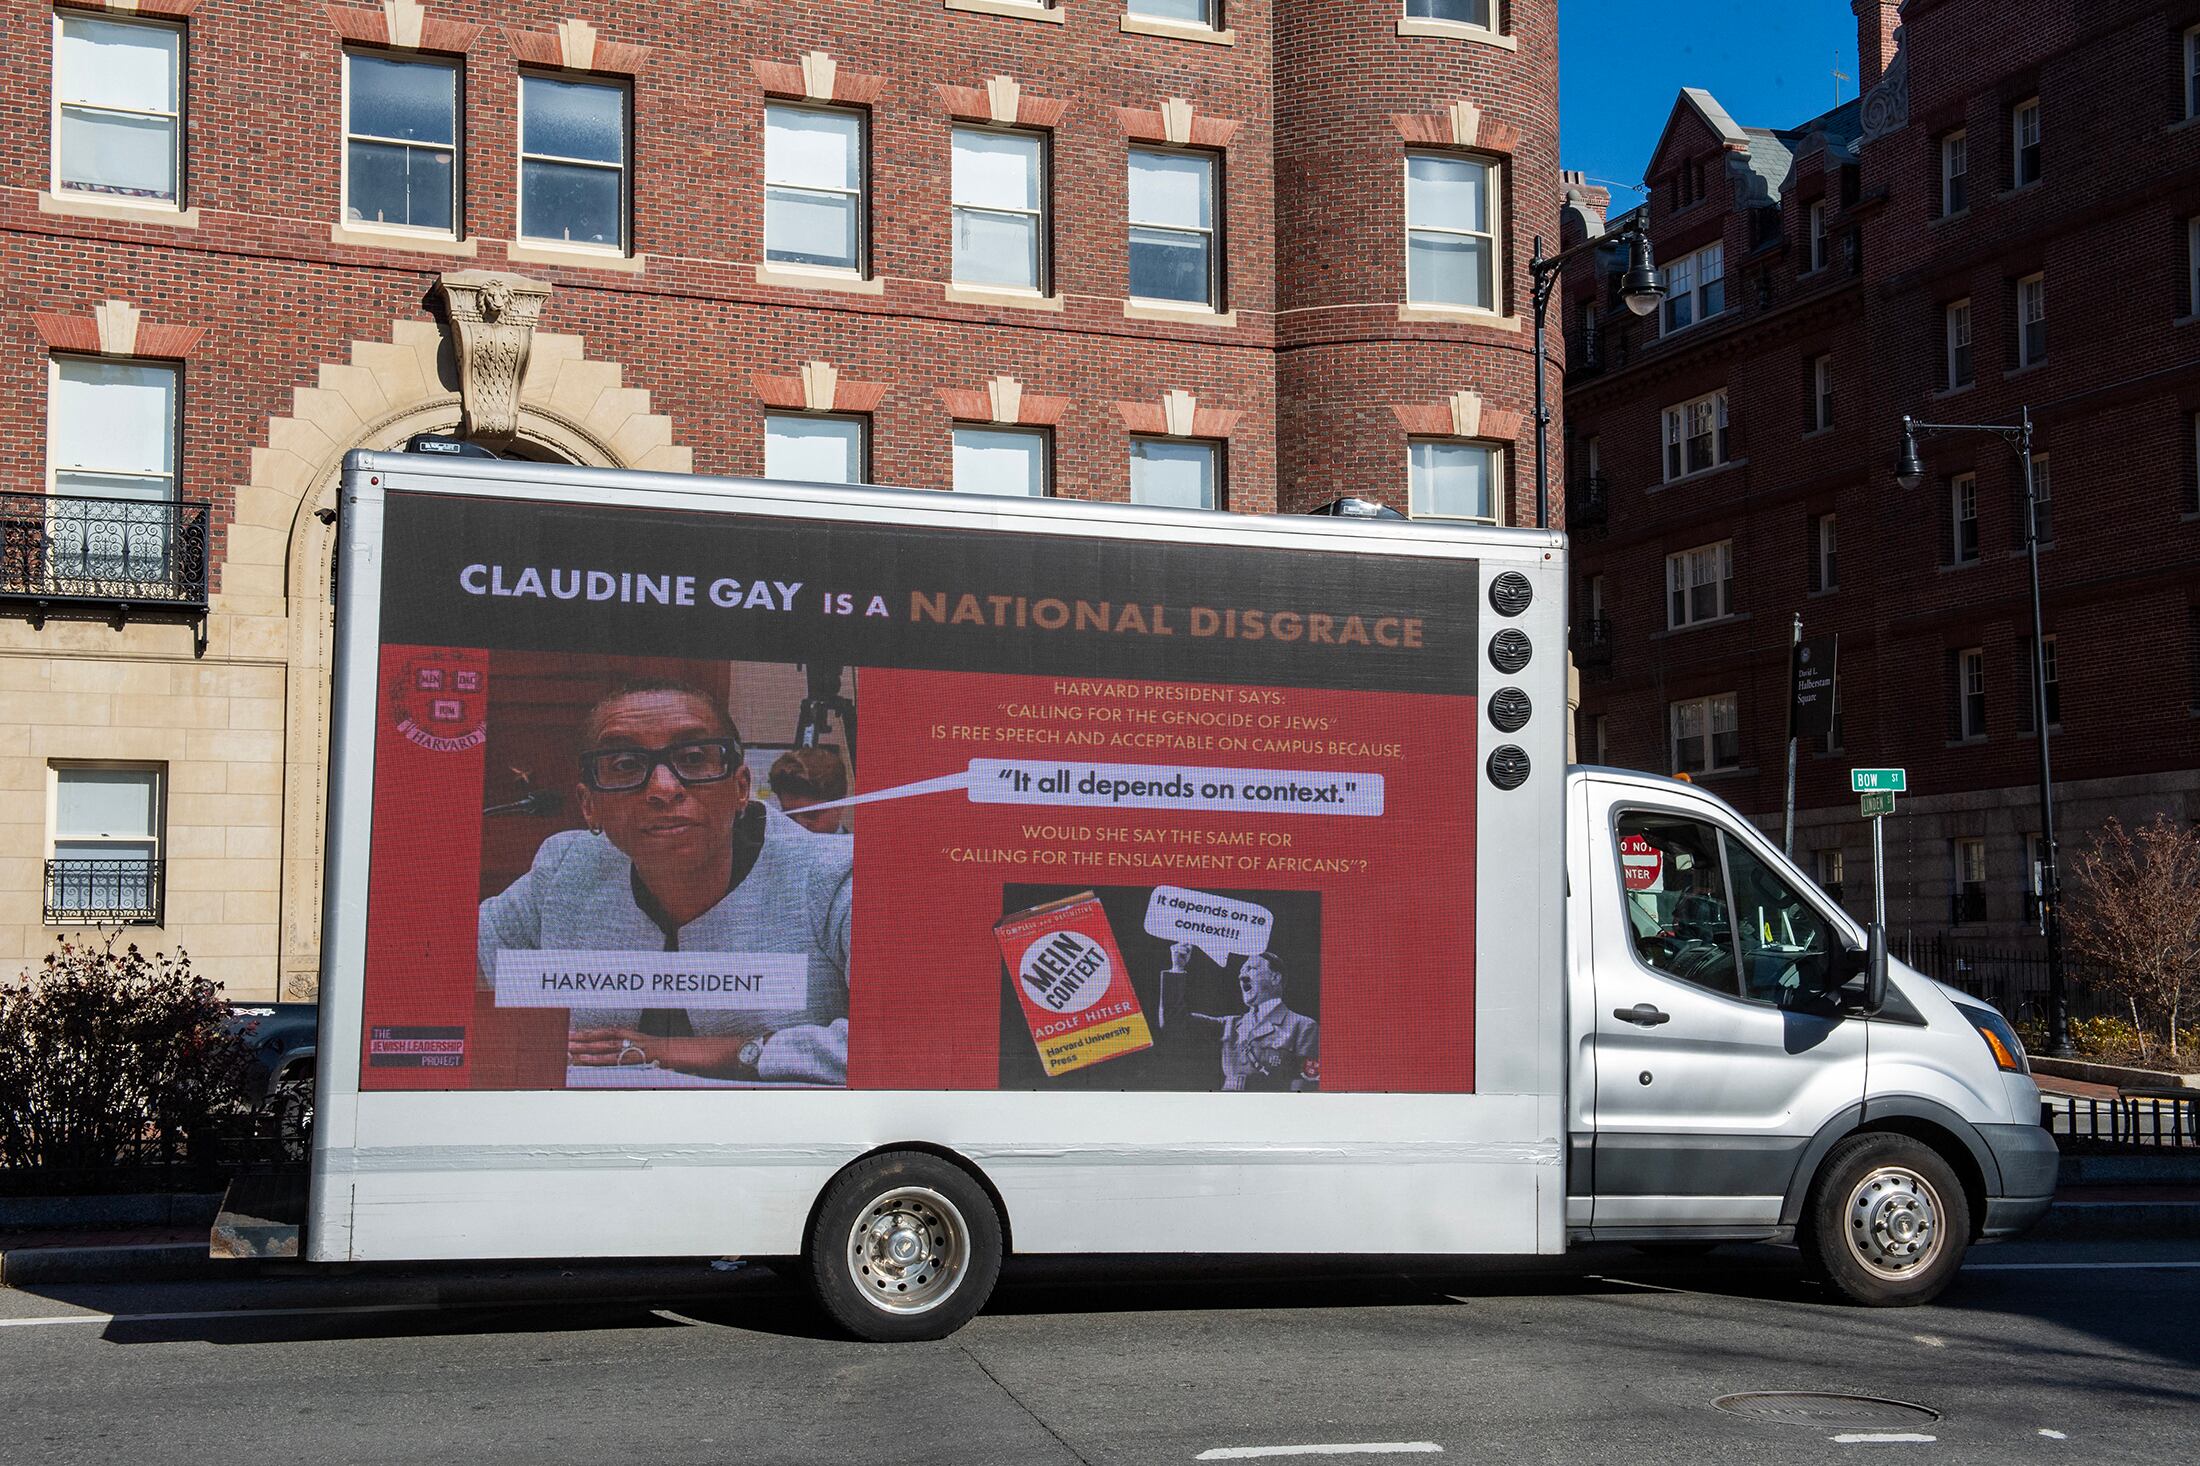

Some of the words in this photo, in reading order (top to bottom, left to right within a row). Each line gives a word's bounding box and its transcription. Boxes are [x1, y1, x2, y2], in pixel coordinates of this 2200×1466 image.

[459, 563, 696, 606] CLAUDINE
[708, 577, 804, 612] GAY
[823, 592, 854, 616] IS
[865, 595, 890, 617] A
[909, 590, 1173, 636] NATIONAL
[1190, 606, 1424, 649] DISGRACE
[1798, 667, 1812, 677] David
[1054, 681, 1139, 698] HARVARD
[1144, 685, 1234, 703] PRESIDENT
[1238, 690, 1286, 705] SAYS:
[1798, 679, 1831, 690] Halberstam
[1797, 694, 1816, 706] Square
[1088, 707, 1122, 722] FOR
[1126, 708, 1158, 723] THE
[1162, 710, 1253, 728] GENOCIDE
[1257, 714, 1281, 729] OF
[412, 731, 479, 751] HARVARD
[931, 724, 947, 740] IS
[952, 725, 990, 741] FREE
[995, 726, 1060, 744] SPEECH
[1064, 730, 1105, 746] AND
[1110, 732, 1214, 751] ACCEPTABLE
[1218, 736, 1248, 752] ON
[1252, 738, 1323, 755] CAMPUS
[1037, 769, 1071, 794] all
[1077, 769, 1195, 801] depends
[1200, 783, 1235, 801] on
[1857, 773, 1878, 787] BOW
[1891, 773, 1899, 783] ST
[1863, 796, 1884, 812] LINDEN
[1022, 825, 1092, 841] WOULD
[1096, 827, 1129, 843] SHE
[1133, 828, 1167, 843] SAY
[1170, 829, 1202, 845] THE
[1206, 830, 1254, 847] SAME
[1259, 832, 1292, 847] FOR
[1620, 841, 1628, 852] O
[1633, 842, 1652, 852] NO
[1033, 849, 1067, 865] FOR
[1072, 851, 1103, 867] THE
[1108, 852, 1234, 870] ENSLAVEMENT
[1238, 855, 1261, 871] OF
[1625, 869, 1650, 879] NTER
[1156, 894, 1167, 906] It
[1168, 897, 1228, 919] depends
[1230, 911, 1248, 922] on
[1251, 914, 1267, 926] ze
[1174, 919, 1240, 940] context!!!
[1022, 932, 1085, 993] MEIN
[541, 972, 645, 990] HARVARD
[652, 974, 764, 992] PRESIDENT
[1046, 947, 1105, 1010] CONTEXT
[1035, 1016, 1079, 1039] ADOLF
[1085, 1001, 1132, 1022] HITLER
[373, 1028, 392, 1039] THE
[1046, 1037, 1084, 1058] Harvard
[1084, 1024, 1131, 1047] University
[373, 1041, 406, 1052] JEWISH
[408, 1041, 463, 1053] LEADERSHIP
[1050, 1053, 1078, 1068] Press
